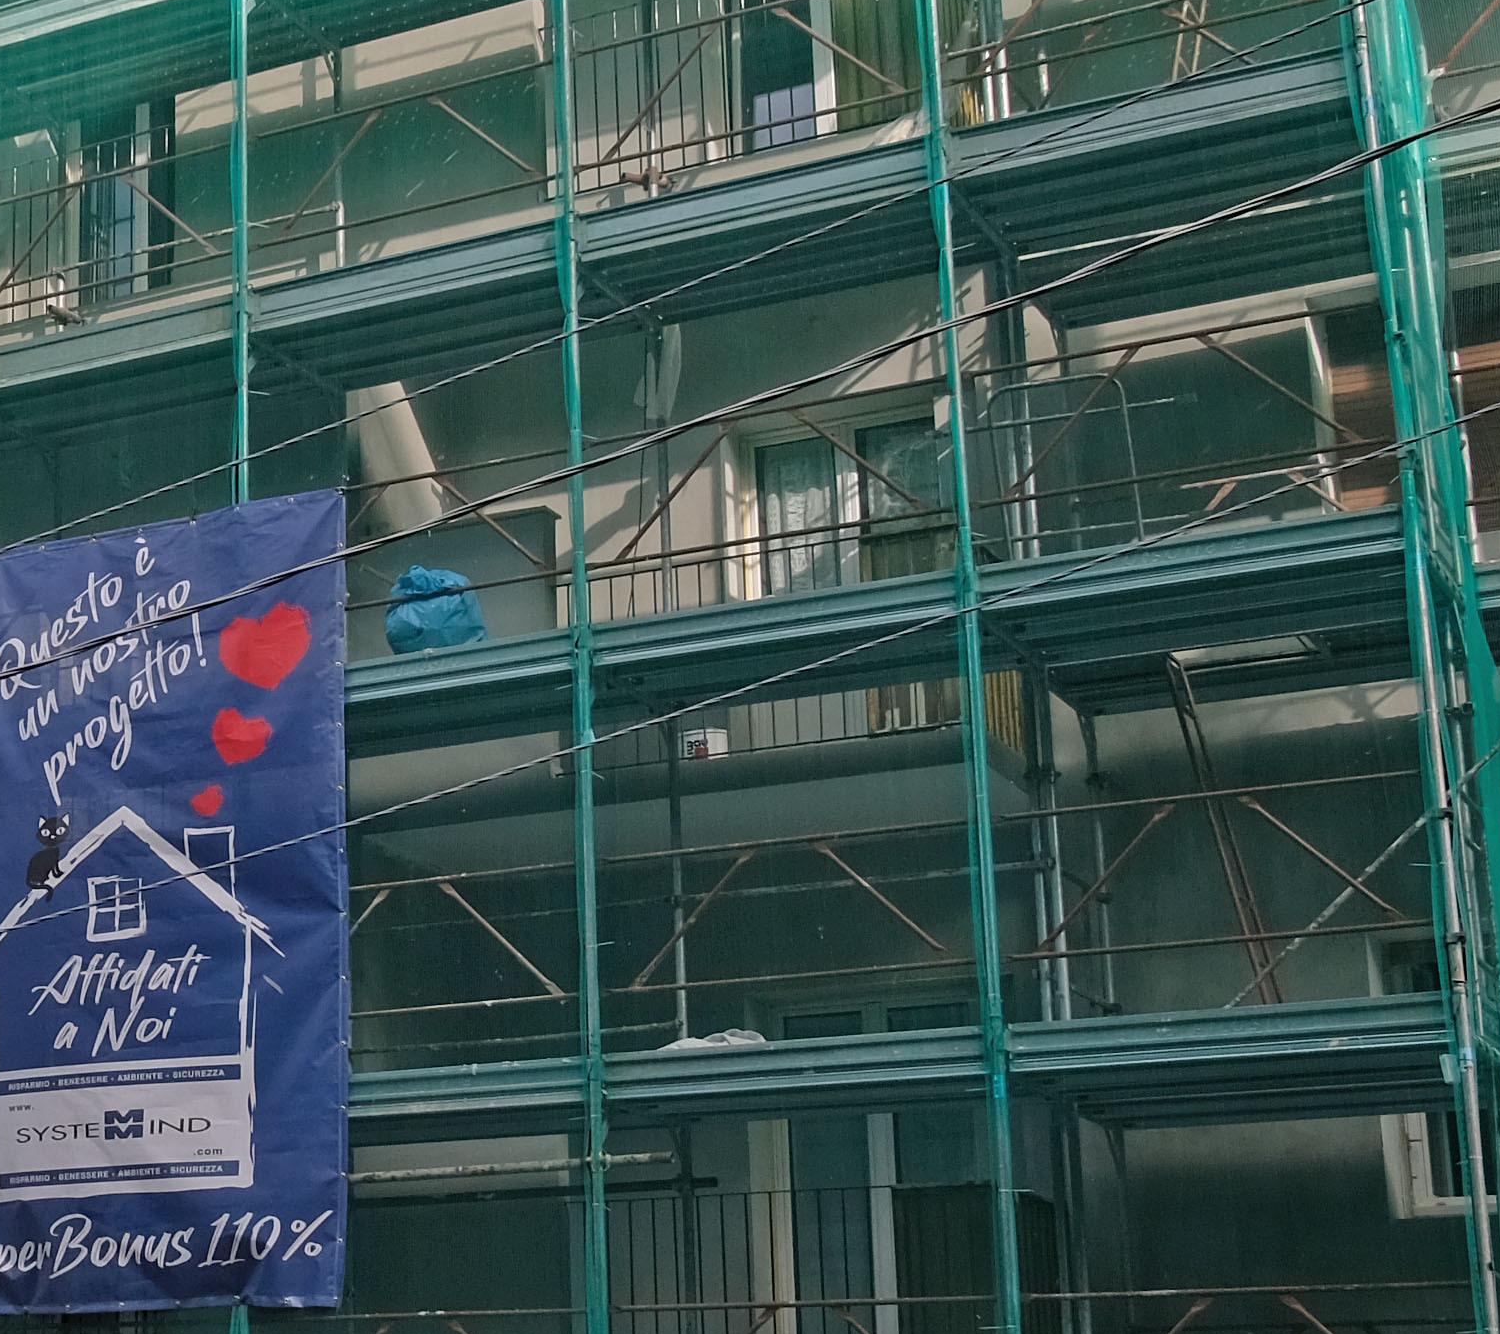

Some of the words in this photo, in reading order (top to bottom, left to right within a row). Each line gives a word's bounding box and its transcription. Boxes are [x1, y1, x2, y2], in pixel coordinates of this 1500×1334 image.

[134, 536, 155, 577] è
[18, 689, 59, 741] un
[72, 579, 191, 696] nostro
[43, 611, 207, 807] progetto!
[27, 944, 212, 1013] Affidati
[53, 1021, 79, 1050] a
[91, 996, 178, 1057] Noi
[8, 1081, 51, 1092] RISPARMIO
[57, 1075, 109, 1087] BENESSERE
[117, 1071, 164, 1082] AMBIENTE
[172, 1068, 225, 1079] SICUREZZA
[15, 1108, 212, 1144] SYSTEMIND
[197, 1210, 334, 1268] 110%
